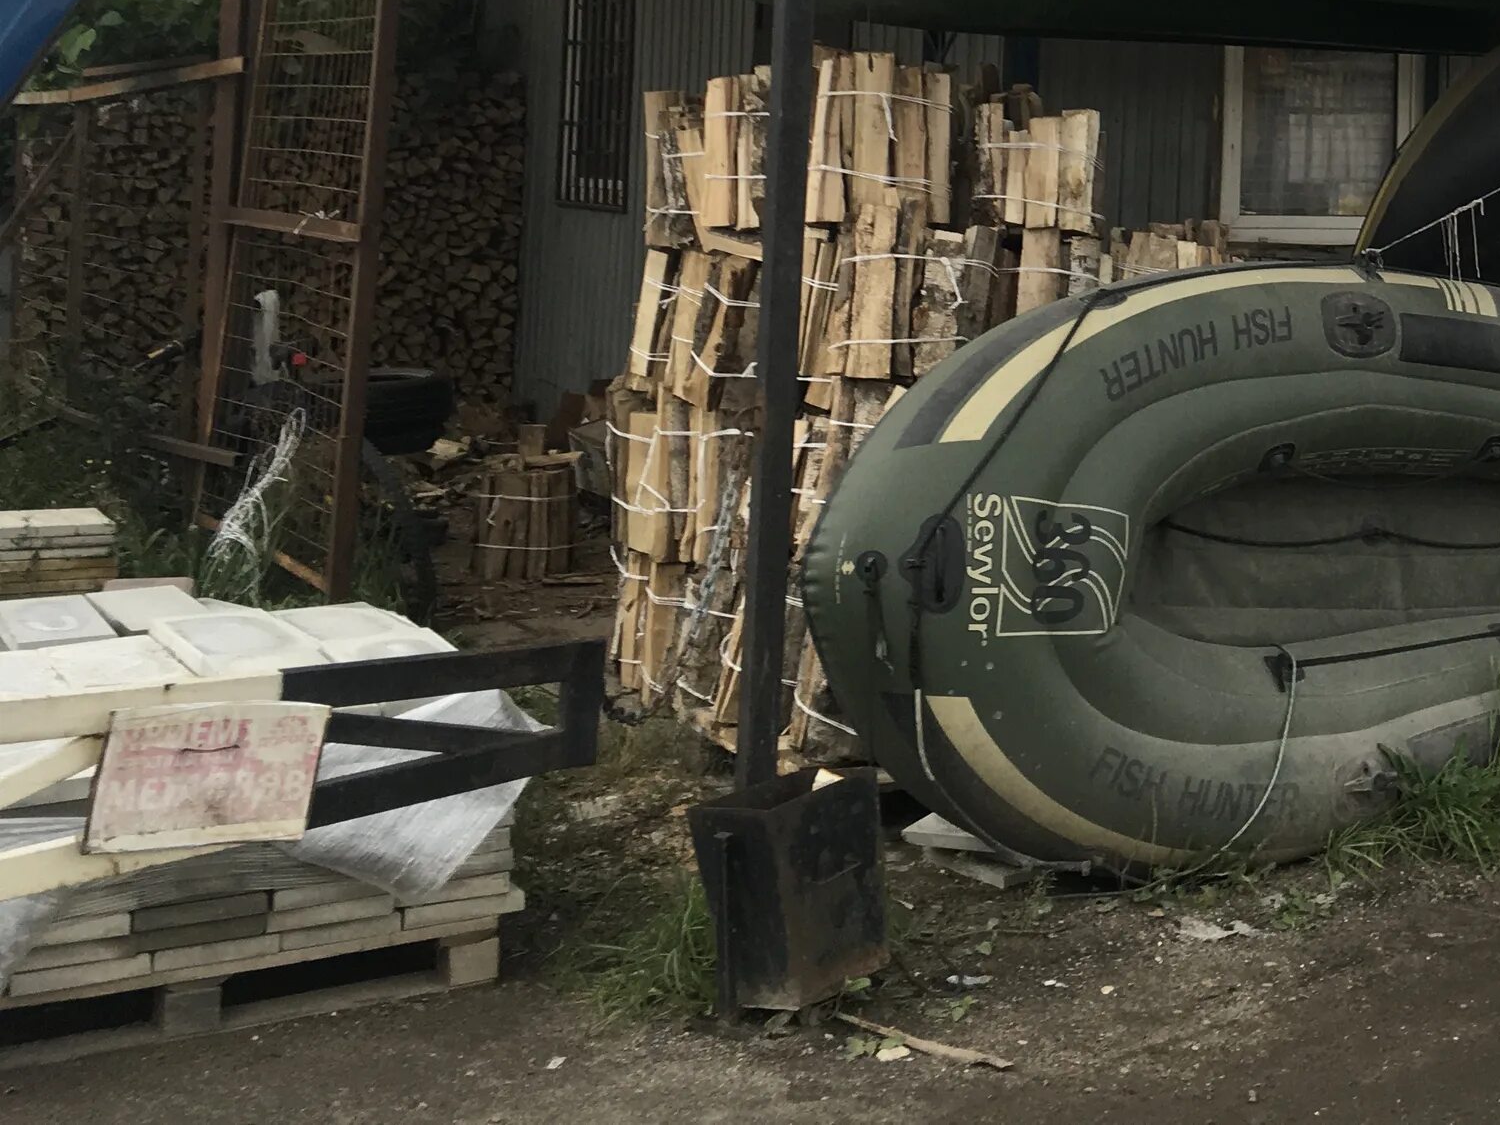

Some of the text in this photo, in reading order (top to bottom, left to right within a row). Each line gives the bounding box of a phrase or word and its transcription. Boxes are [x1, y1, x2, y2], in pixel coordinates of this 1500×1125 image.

[1098, 305, 1293, 403] FISH HUNTER
[967, 492, 1002, 640] Sevylor
[1030, 509, 1093, 625] 360
[1088, 745, 1302, 824] FISH HUNTER
